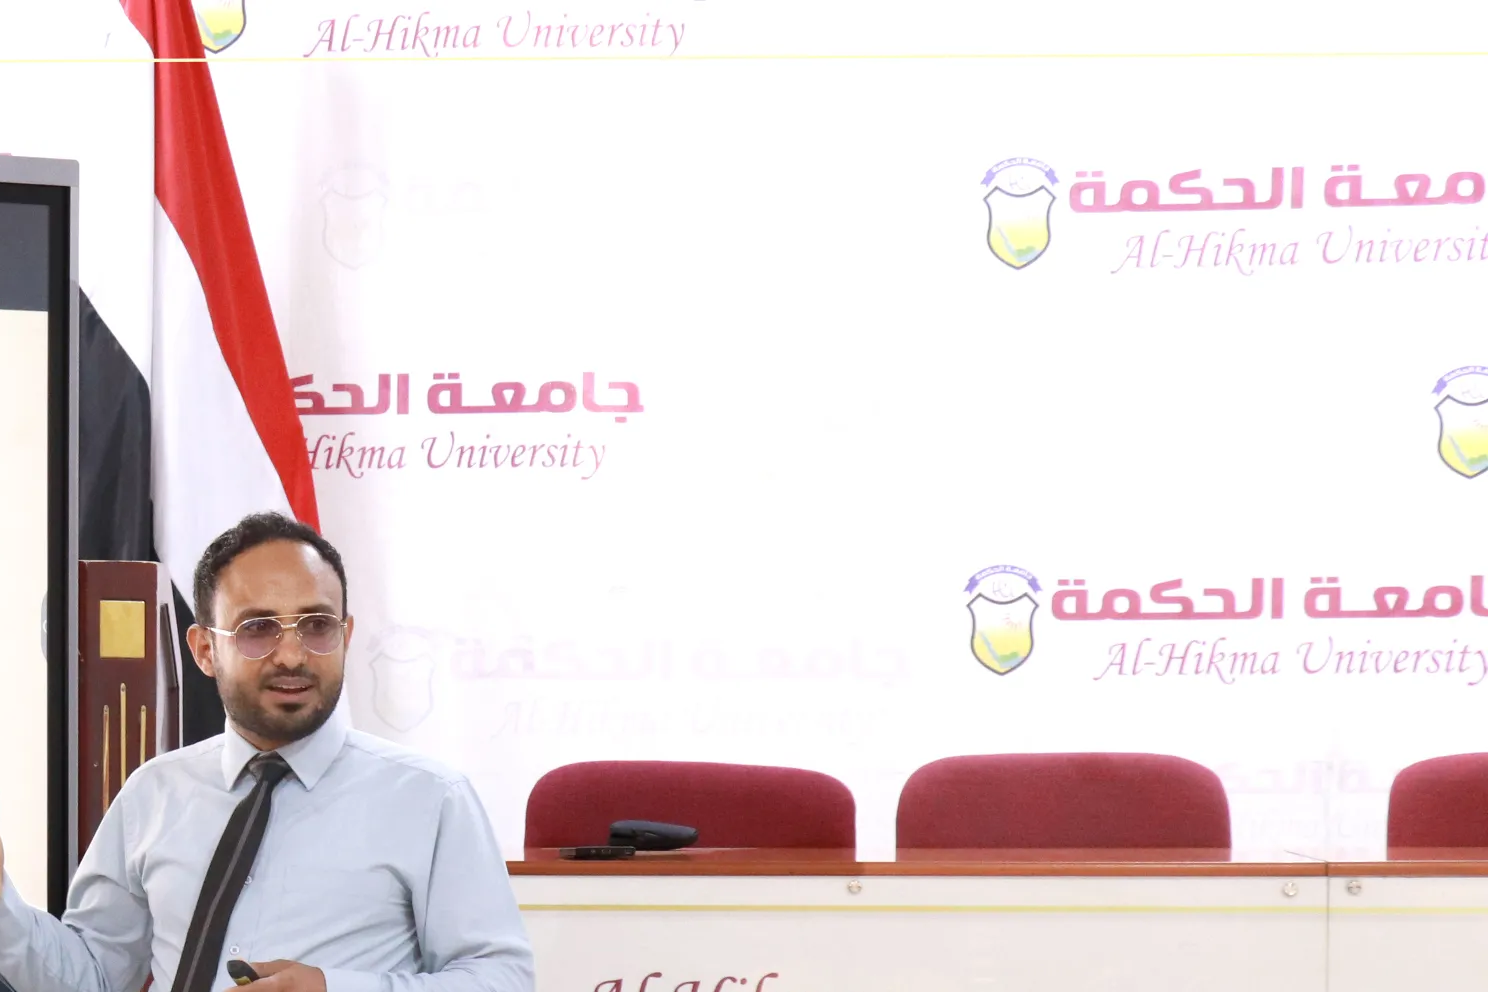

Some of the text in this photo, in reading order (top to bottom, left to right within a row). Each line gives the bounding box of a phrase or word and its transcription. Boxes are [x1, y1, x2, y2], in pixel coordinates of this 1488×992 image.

[303, 11, 687, 58] Al-Hikma University
[1069, 164, 1488, 215] معة الحكمة
[1111, 225, 1488, 278] Al-Hikma Universit
[289, 372, 646, 425] جامعة الحك
[307, 425, 607, 483] Hikma University
[1051, 575, 1488, 623] امعة الحكمة
[1093, 636, 1488, 688] Al-Hikma University
